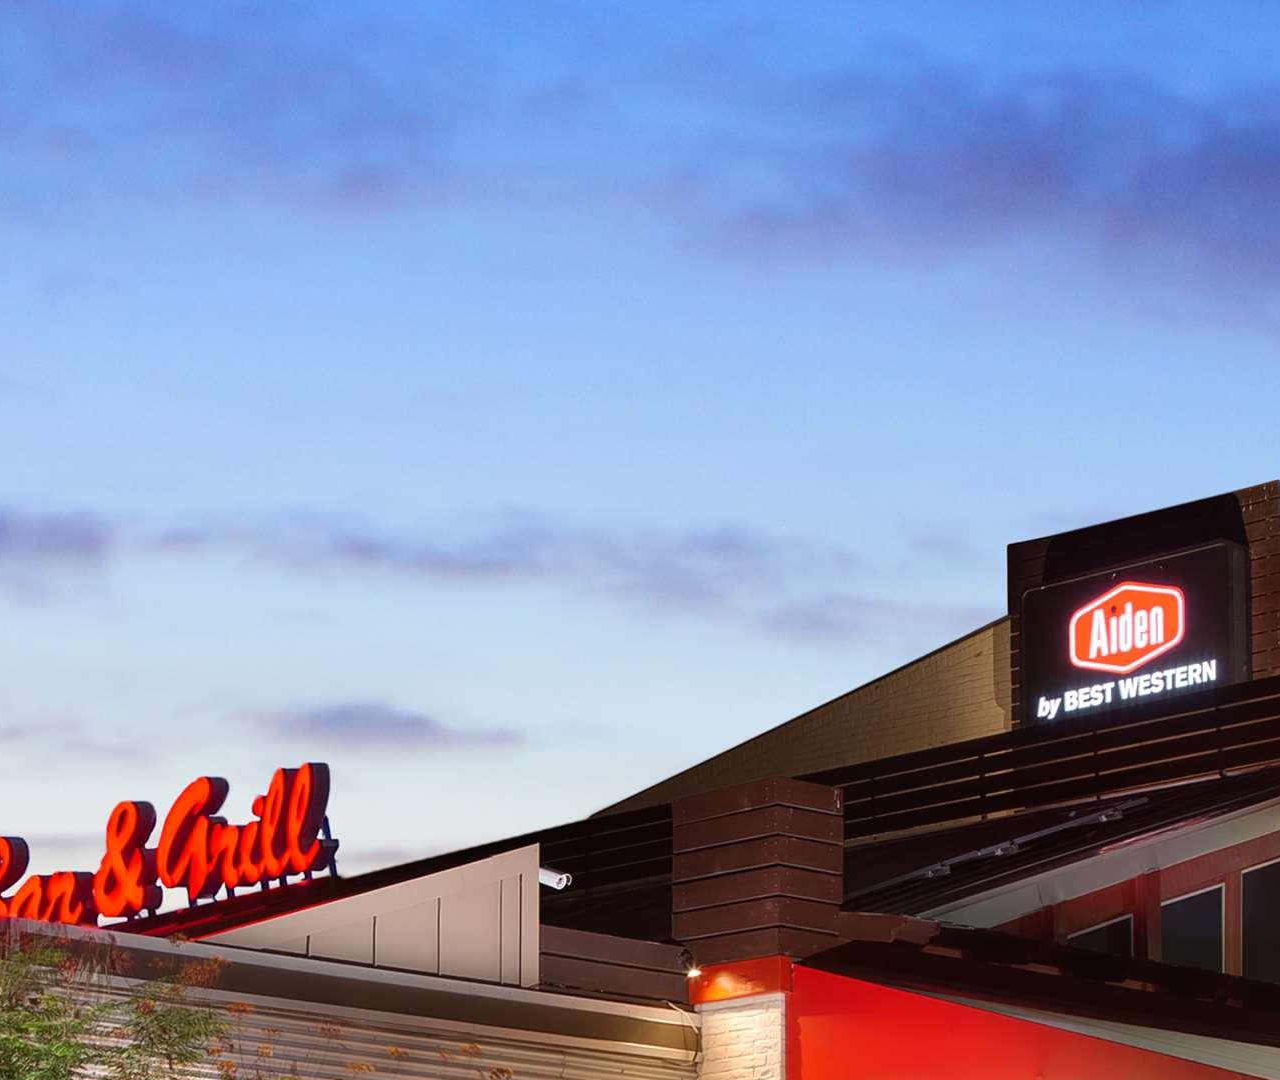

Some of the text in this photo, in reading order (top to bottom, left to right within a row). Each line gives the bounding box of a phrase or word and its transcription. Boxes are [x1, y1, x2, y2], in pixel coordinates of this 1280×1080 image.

[1089, 602, 1165, 659] Aiden
[1037, 659, 1218, 720] by BEST WESTERN
[93, 800, 147, 917] &
[155, 761, 322, 901] Grill
